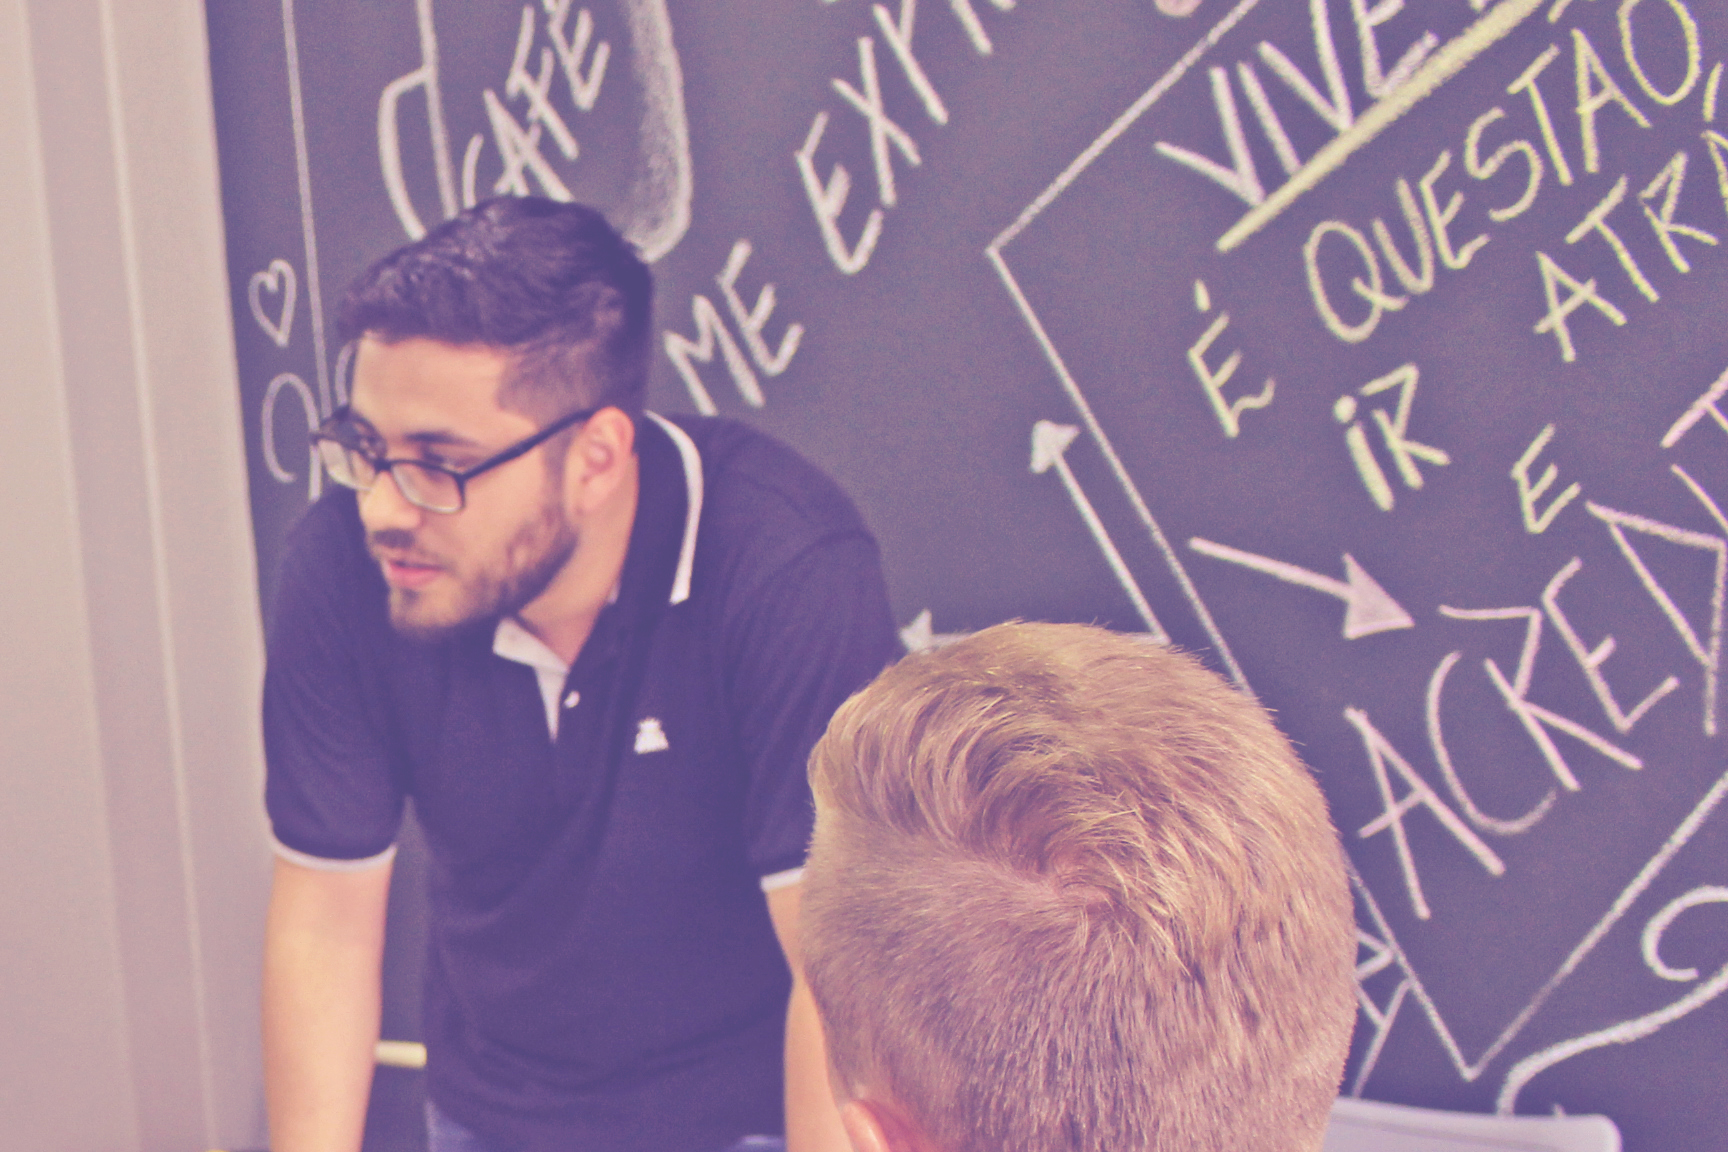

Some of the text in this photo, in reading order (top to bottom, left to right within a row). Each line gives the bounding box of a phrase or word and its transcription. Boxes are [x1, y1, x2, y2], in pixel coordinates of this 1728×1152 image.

[664, 239, 806, 417] ME
[1186, 279, 1275, 438] É
[1510, 423, 1582, 534] E
